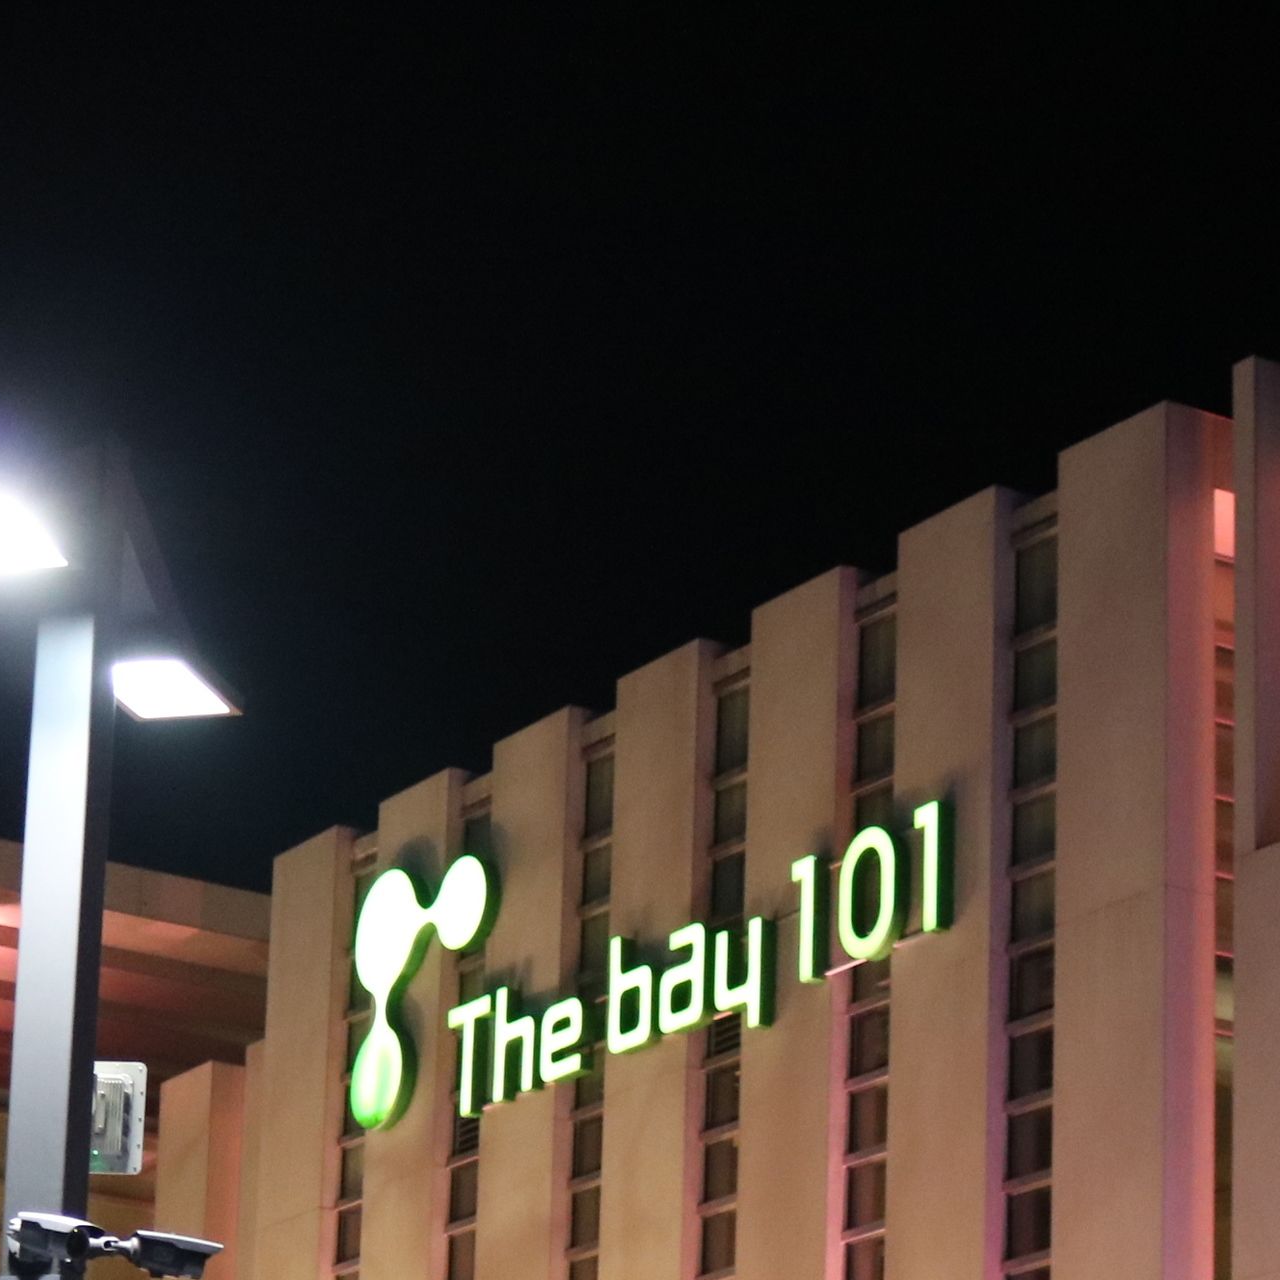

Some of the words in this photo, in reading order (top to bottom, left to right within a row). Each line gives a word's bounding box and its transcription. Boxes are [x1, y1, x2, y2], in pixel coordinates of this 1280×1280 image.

[447, 985, 586, 1118] The
[606, 915, 774, 1054] bay
[790, 800, 953, 984] 101
